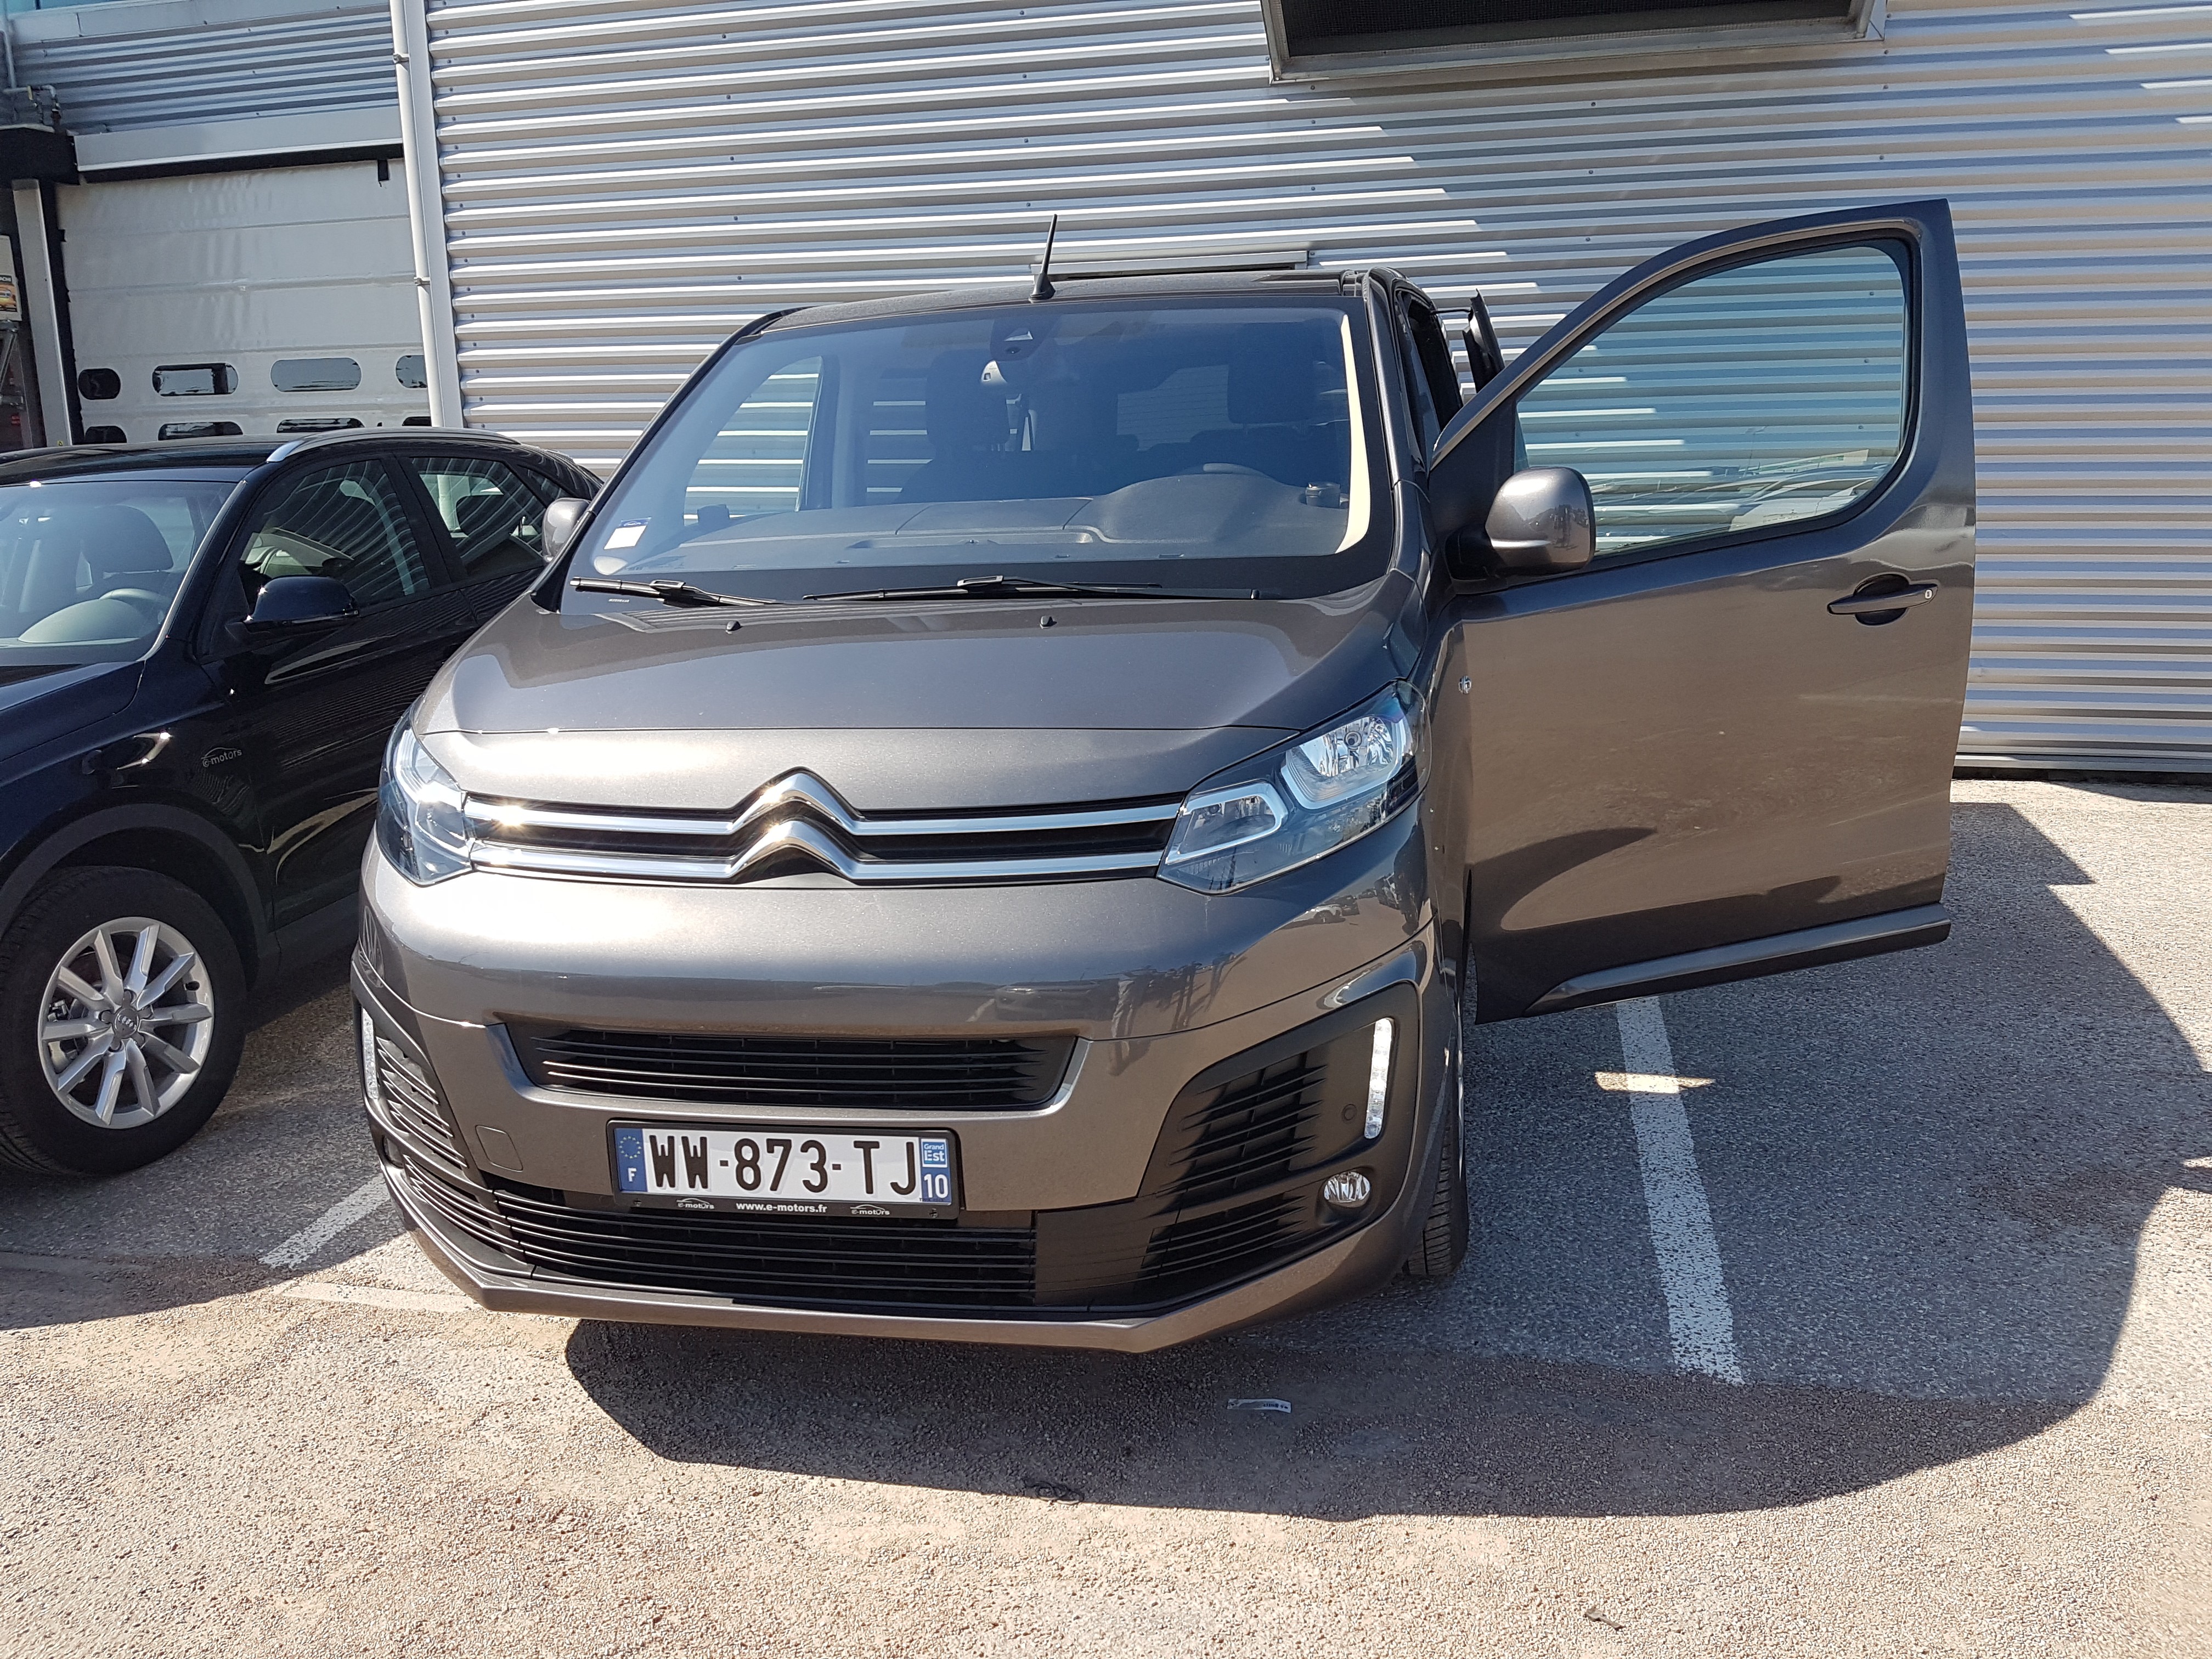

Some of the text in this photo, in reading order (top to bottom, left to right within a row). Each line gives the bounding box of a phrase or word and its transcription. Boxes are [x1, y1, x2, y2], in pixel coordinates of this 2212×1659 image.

[202, 749, 242, 768] e-motors
[924, 1150, 945, 1162] Est
[649, 1135, 916, 1195] WW-873-TJ
[628, 1167, 637, 1182] F
[924, 1173, 949, 1199] 10
[736, 1203, 828, 1213] www.e-motors.fr
